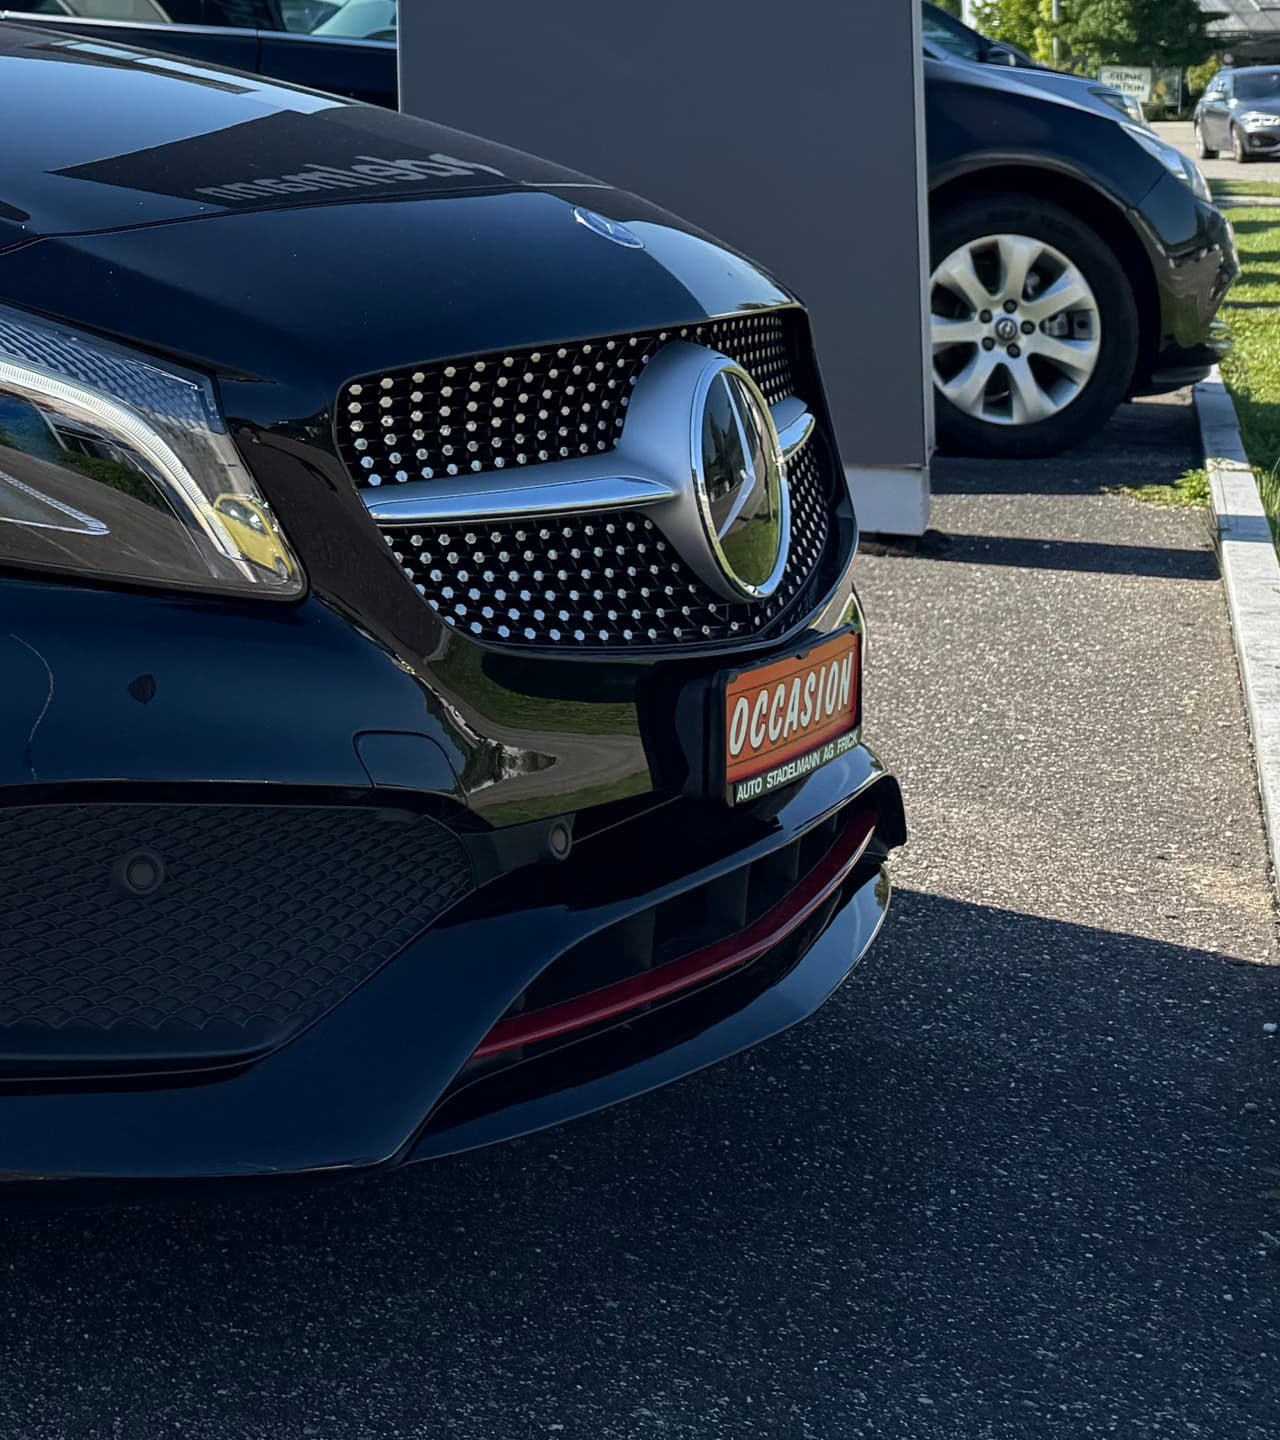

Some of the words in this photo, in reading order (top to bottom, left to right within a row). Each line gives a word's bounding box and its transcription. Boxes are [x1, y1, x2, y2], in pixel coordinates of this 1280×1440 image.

[729, 651, 854, 756] OCCASION
[736, 776, 763, 802] AUTO
[766, 750, 821, 789] STADELMANN
[822, 743, 835, 763] AG
[836, 729, 859, 754] FRICK
